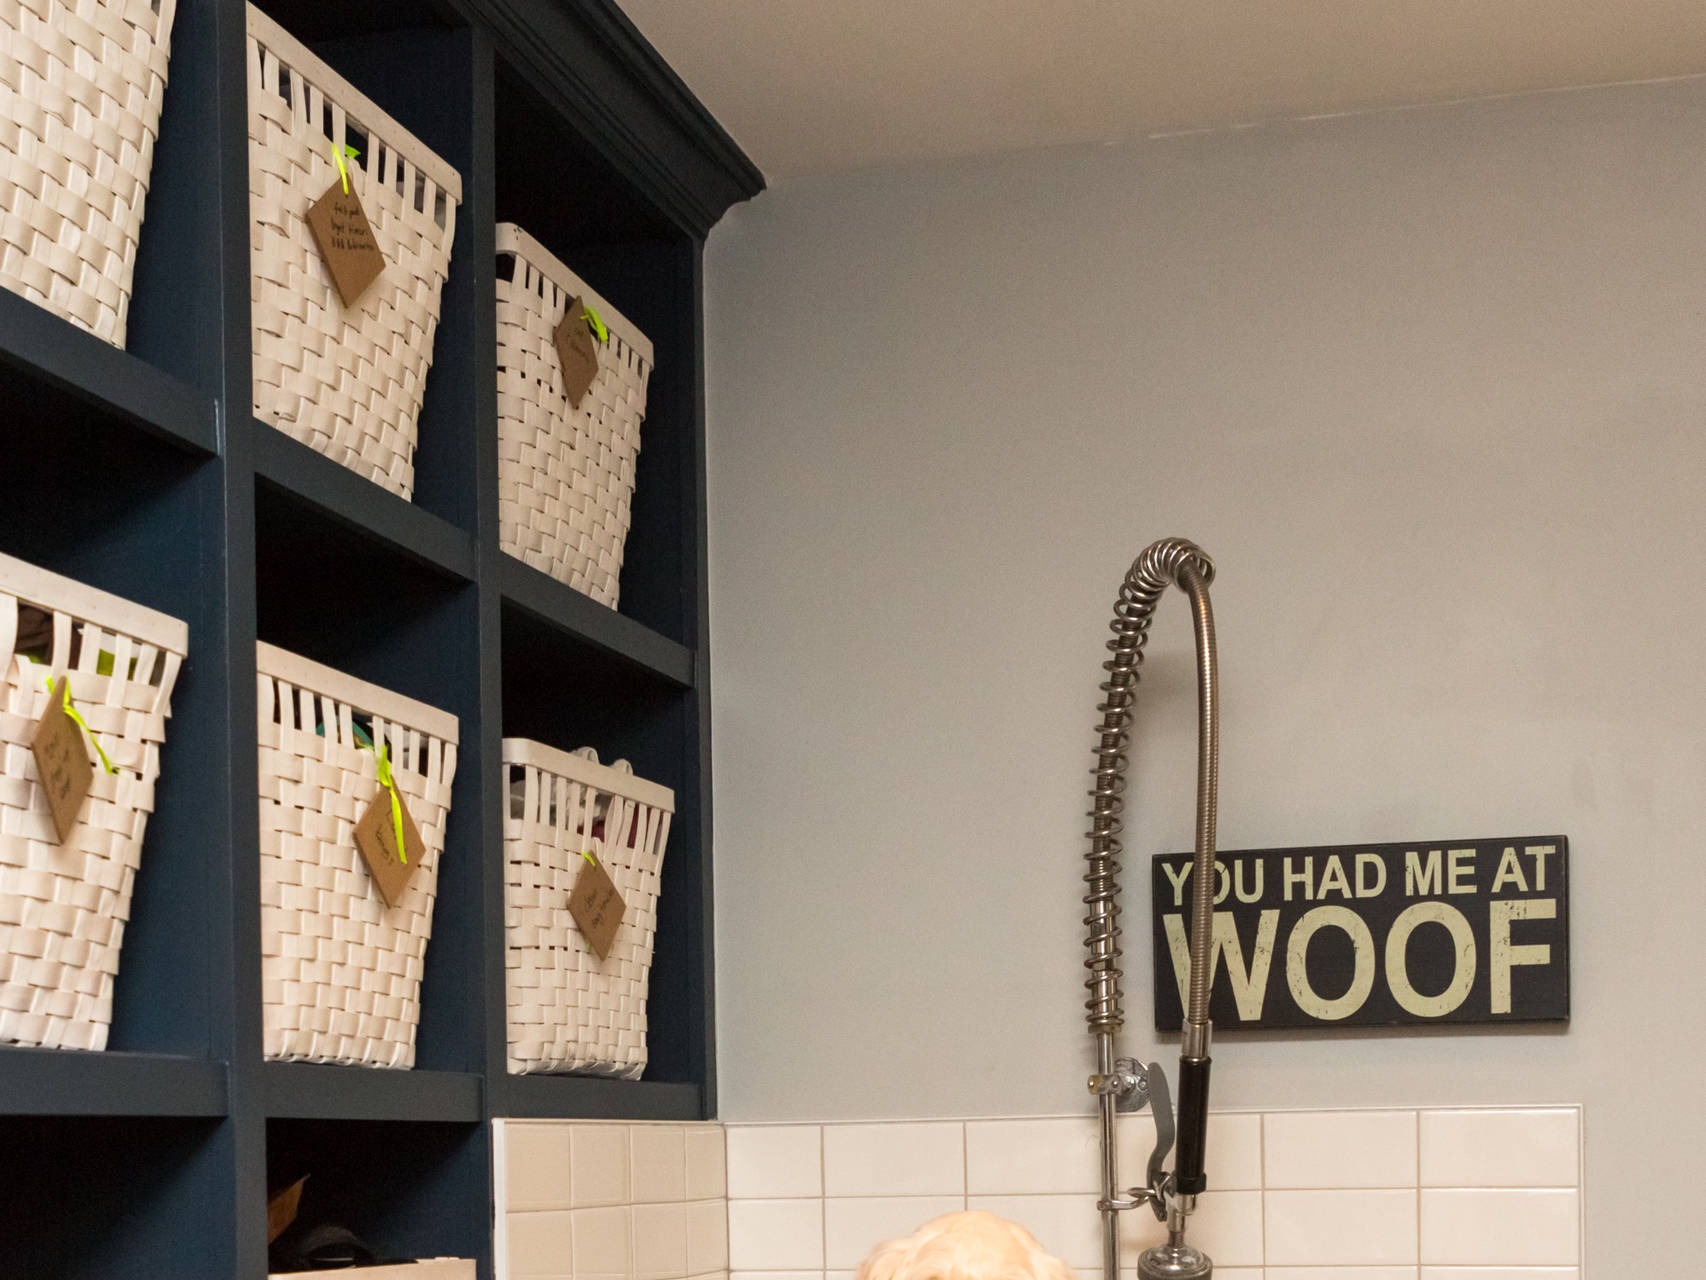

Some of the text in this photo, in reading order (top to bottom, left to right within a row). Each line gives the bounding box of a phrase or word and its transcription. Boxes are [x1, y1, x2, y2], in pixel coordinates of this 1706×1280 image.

[1161, 845, 1557, 906] YOU HAD ME AT
[1162, 898, 1557, 1022] WOOF
